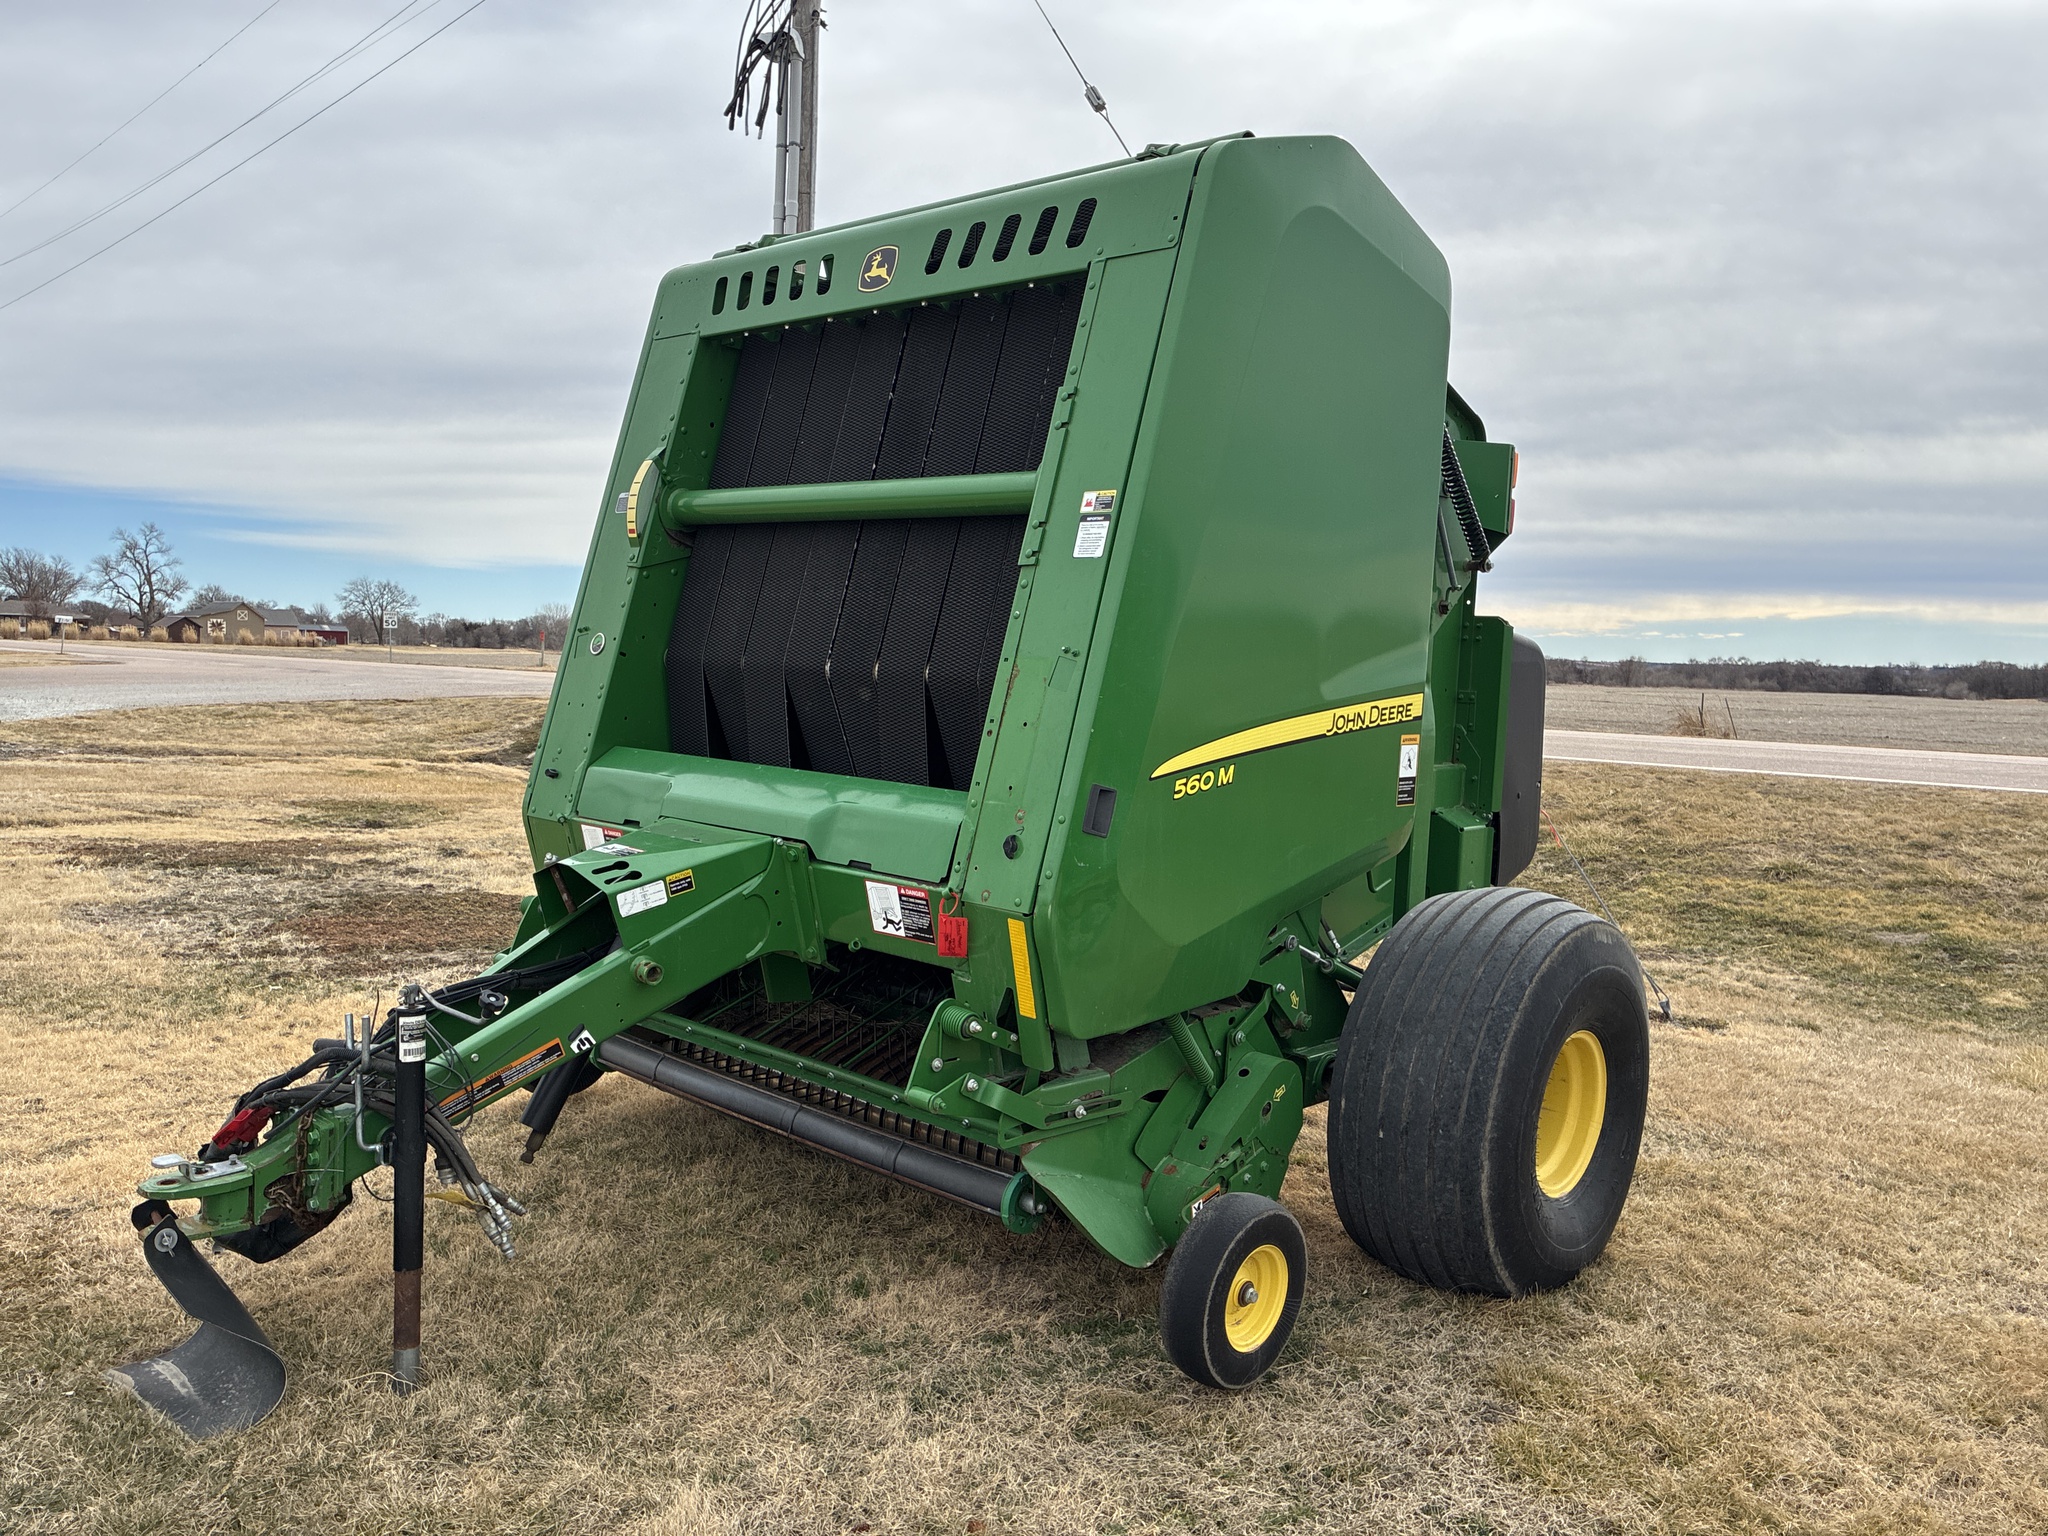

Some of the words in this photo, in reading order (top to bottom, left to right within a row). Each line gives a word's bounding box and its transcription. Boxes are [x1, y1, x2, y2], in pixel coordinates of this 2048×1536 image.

[1326, 710, 1366, 733] JOHN
[1369, 703, 1413, 724] DEERE
[1173, 770, 1215, 800] 560
[1217, 763, 1235, 787] M
[671, 871, 691, 880] CAUTION
[905, 889, 926, 898] DANGER
[489, 1064, 513, 1080] WARNING
